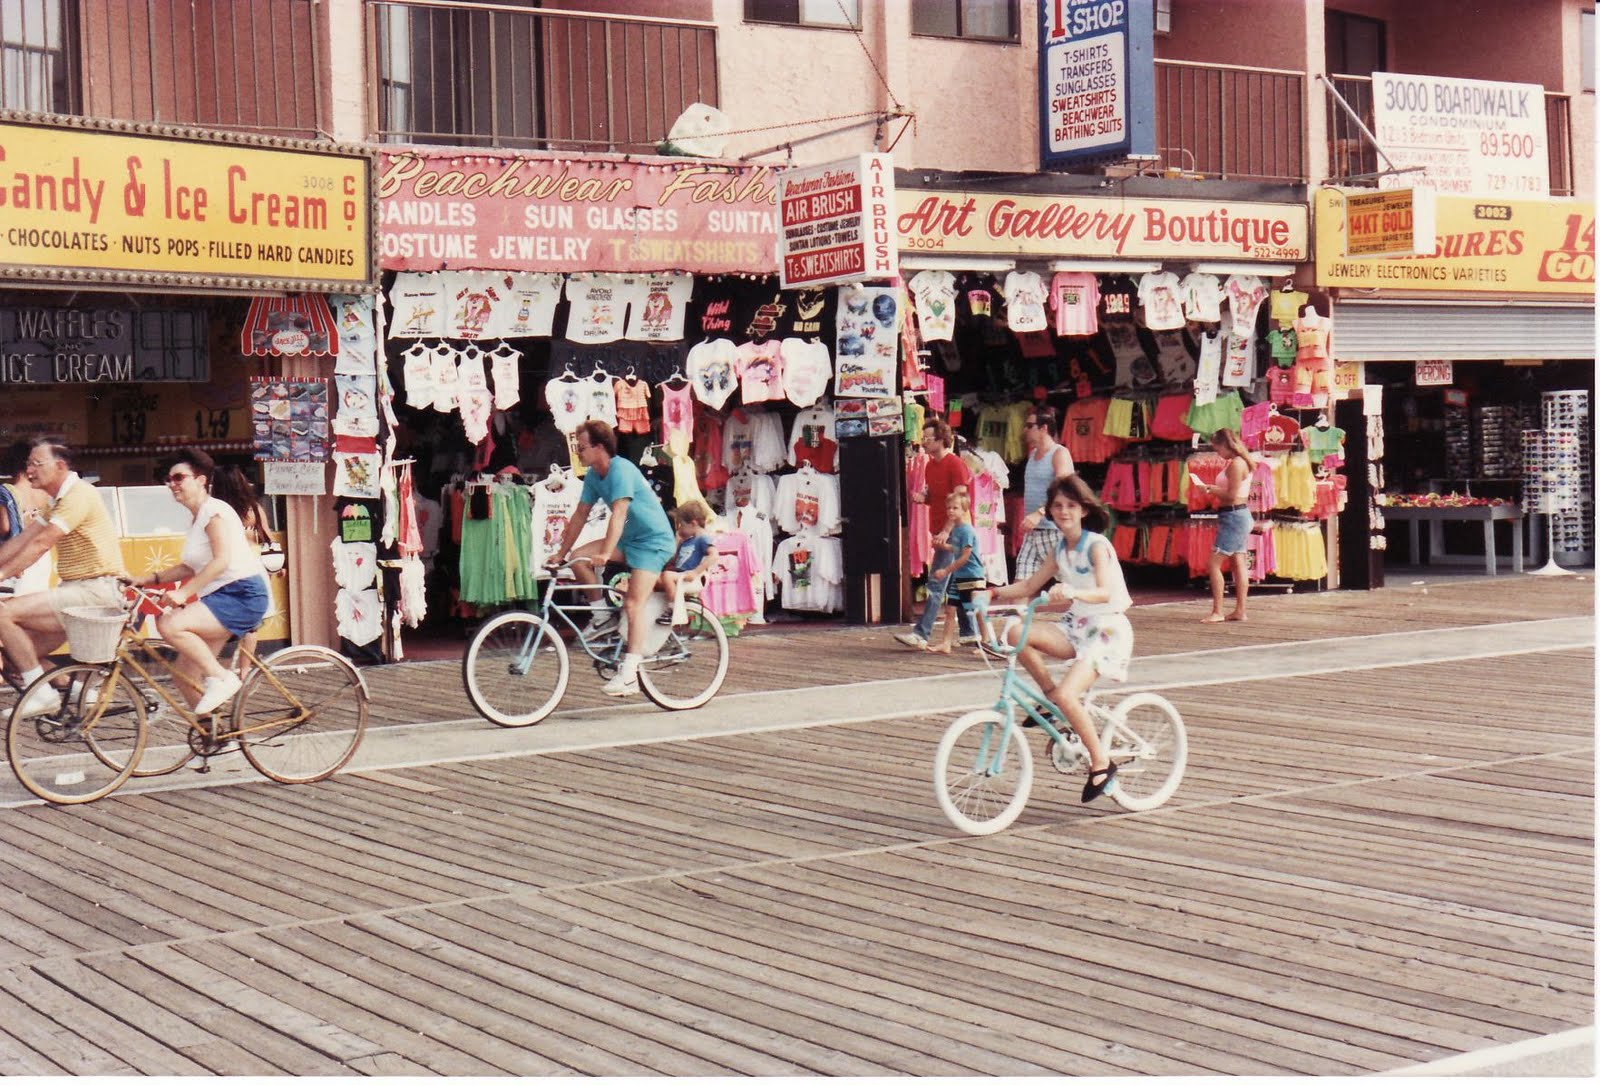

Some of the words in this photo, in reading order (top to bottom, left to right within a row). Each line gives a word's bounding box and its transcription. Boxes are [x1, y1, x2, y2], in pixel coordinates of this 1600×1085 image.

[1073, 1, 1124, 34] SHOP
[1064, 44, 1108, 63] T-SHIRTS
[1061, 59, 1113, 80] TRANSFERS
[1055, 74, 1116, 96] SUNGLASSES
[1052, 89, 1117, 113] SWEATSHIRTS
[1385, 80, 1430, 111] 3000
[1434, 84, 1529, 118] BOARDWALK
[1062, 105, 1115, 125] BEACHWEAR
[1410, 115, 1507, 130] CONDOMINIUM
[1055, 125, 1096, 142] BATHING
[1098, 119, 1122, 137] SUITS
[123, 155, 145, 217] &
[163, 158, 207, 222] Ice
[228, 165, 327, 230] Cream
[303, 176, 334, 190] 3008
[785, 178, 823, 197] Beachwear
[823, 170, 855, 188] Fashions
[786, 199, 808, 223] AIR
[811, 189, 854, 217] BRUSH
[1349, 196, 1386, 207] TREASURES
[1382, 201, 1412, 212] JEWELRY
[525, 204, 573, 230] SUN
[586, 206, 678, 232] GLASSES
[707, 209, 779, 234] SUNTA
[897, 196, 977, 237] Art
[988, 199, 1136, 254] Gallery
[1143, 207, 1289, 253] Boutique
[1382, 210, 1413, 233] GOLD
[8, 228, 108, 251] CHOCOLATES
[122, 235, 161, 255] NUTS
[168, 238, 199, 257] POPS
[209, 241, 252, 260] FILLED
[258, 244, 292, 262] HARD
[298, 247, 354, 266] CANDIES
[380, 232, 477, 259] OSTUME
[490, 235, 592, 262] JEWELRY
[789, 238, 809, 252] SUNTAN
[810, 233, 832, 248] LOTIONS
[834, 229, 858, 243] TOWELS
[907, 237, 945, 249] 3004
[1382, 232, 1413, 242] VARIETIES
[1328, 263, 1372, 278] JEWELRY
[1377, 264, 1447, 281] ELECTRONICS
[1453, 266, 1508, 282] VARIETIES
[706, 300, 730, 316] Wild
[19, 309, 124, 339] WAFFLES
[702, 316, 731, 332] Thing
[2, 353, 36, 383] ICE
[55, 353, 132, 383] CREAM
[1416, 364, 1451, 381] PIERCING
